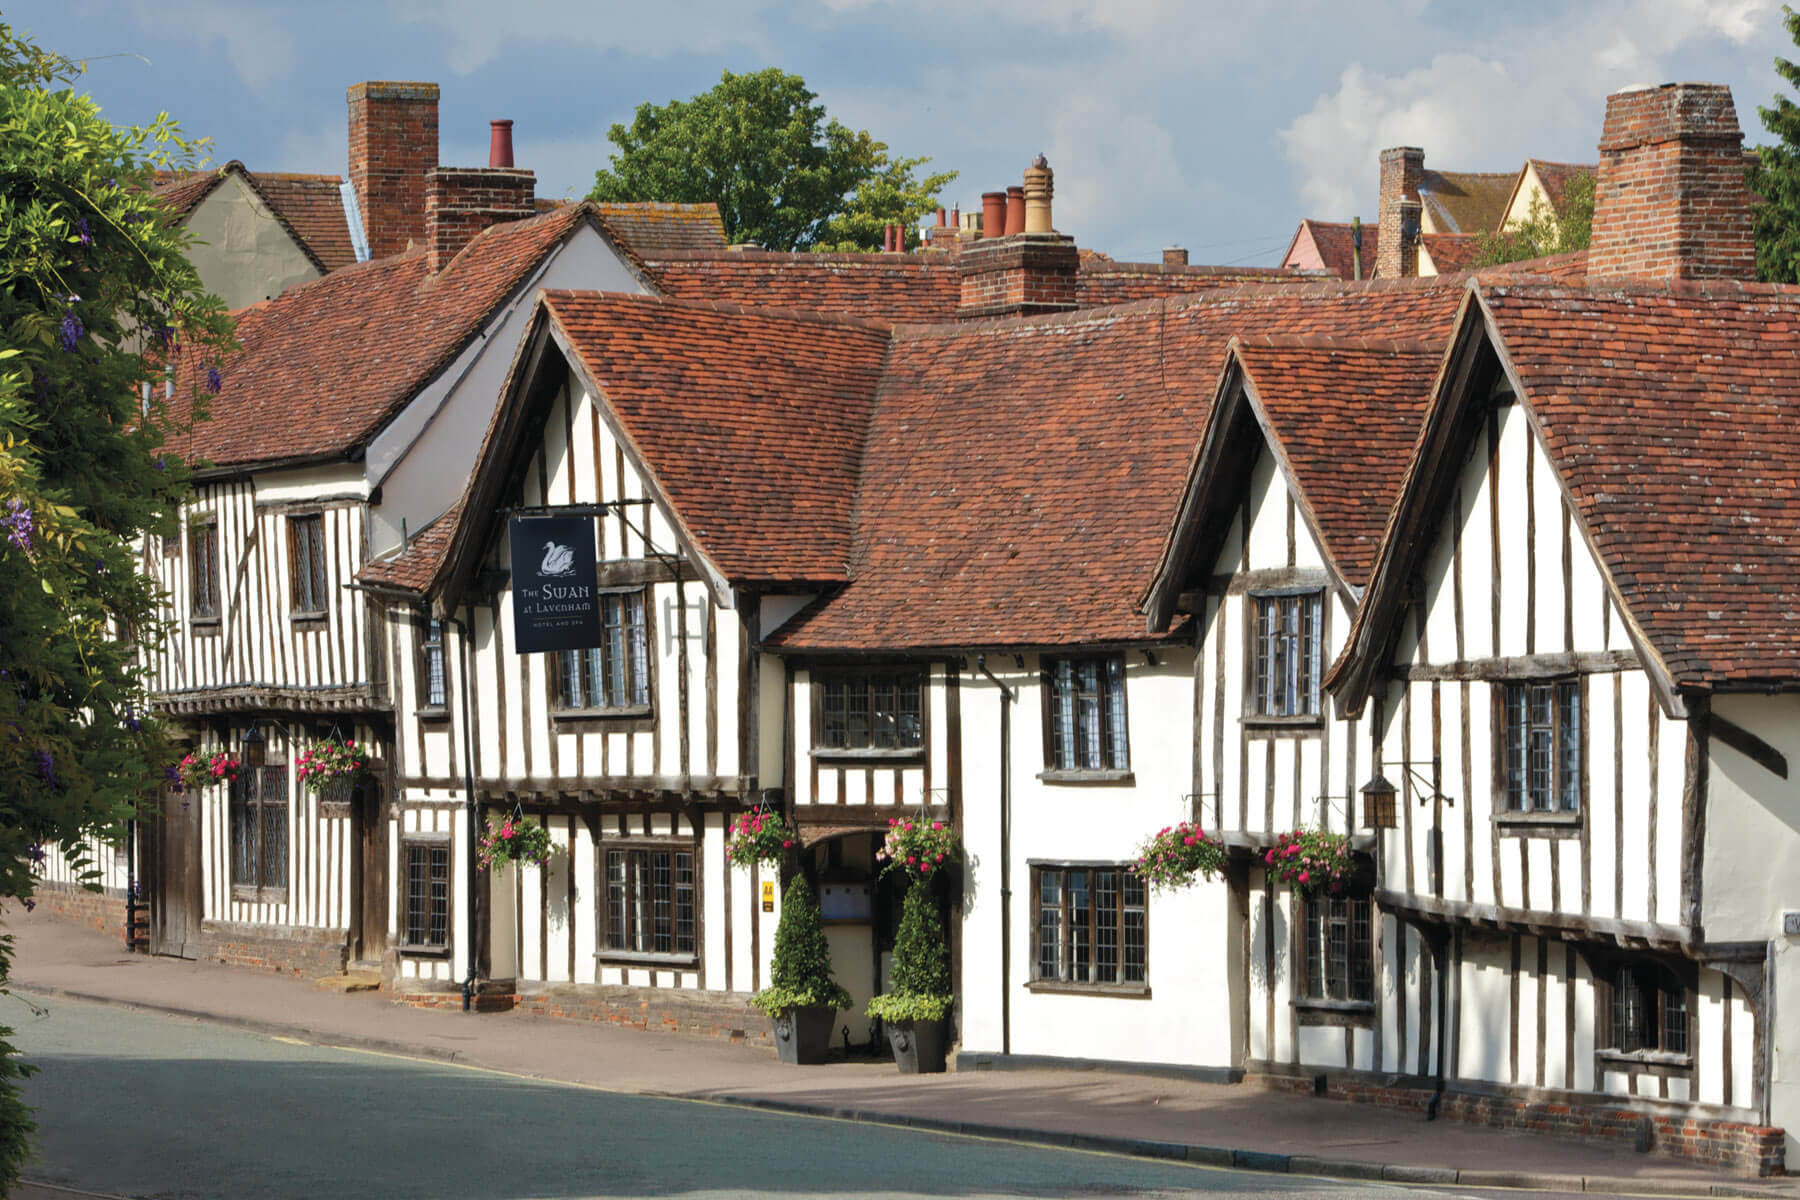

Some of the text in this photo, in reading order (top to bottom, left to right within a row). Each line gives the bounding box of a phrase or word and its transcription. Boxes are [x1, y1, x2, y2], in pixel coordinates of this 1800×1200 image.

[522, 584, 589, 600] THE SWAN
[536, 602, 590, 613] LAVENHAM
[764, 884, 773, 896] AA
